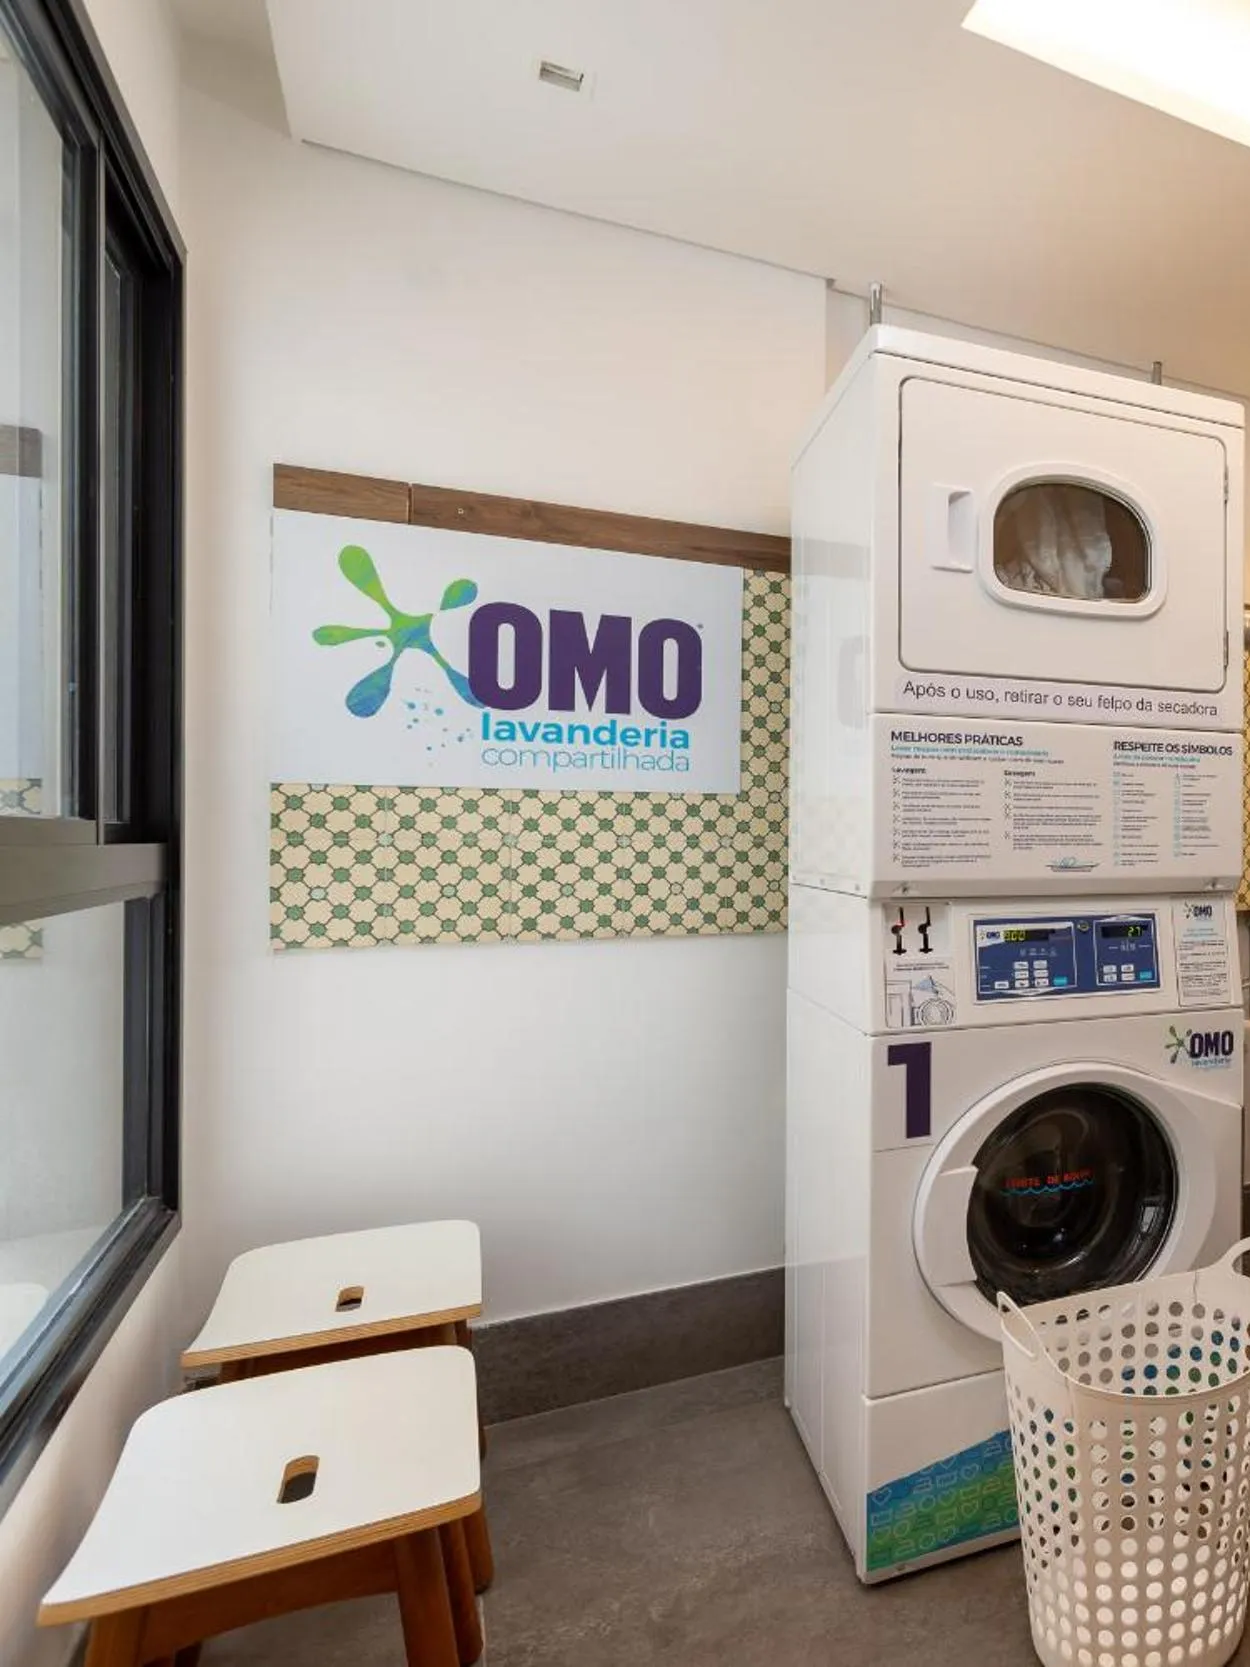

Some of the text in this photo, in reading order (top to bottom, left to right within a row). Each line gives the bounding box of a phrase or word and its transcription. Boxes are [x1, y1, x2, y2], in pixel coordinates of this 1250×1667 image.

[469, 602, 702, 719] OMO
[903, 680, 1217, 716] Após o uso, retirar o seu felpo da secadora
[481, 711, 690, 749] lavanderia
[890, 731, 1024, 747] MELHORES PRÁTICAS
[481, 747, 690, 773] compartilhada
[1113, 740, 1233, 756] RESPEITE OS SÍMBOLOS
[1193, 905, 1212, 918] OMO
[1190, 1030, 1234, 1059] OMO
[887, 1041, 932, 1139] 1
